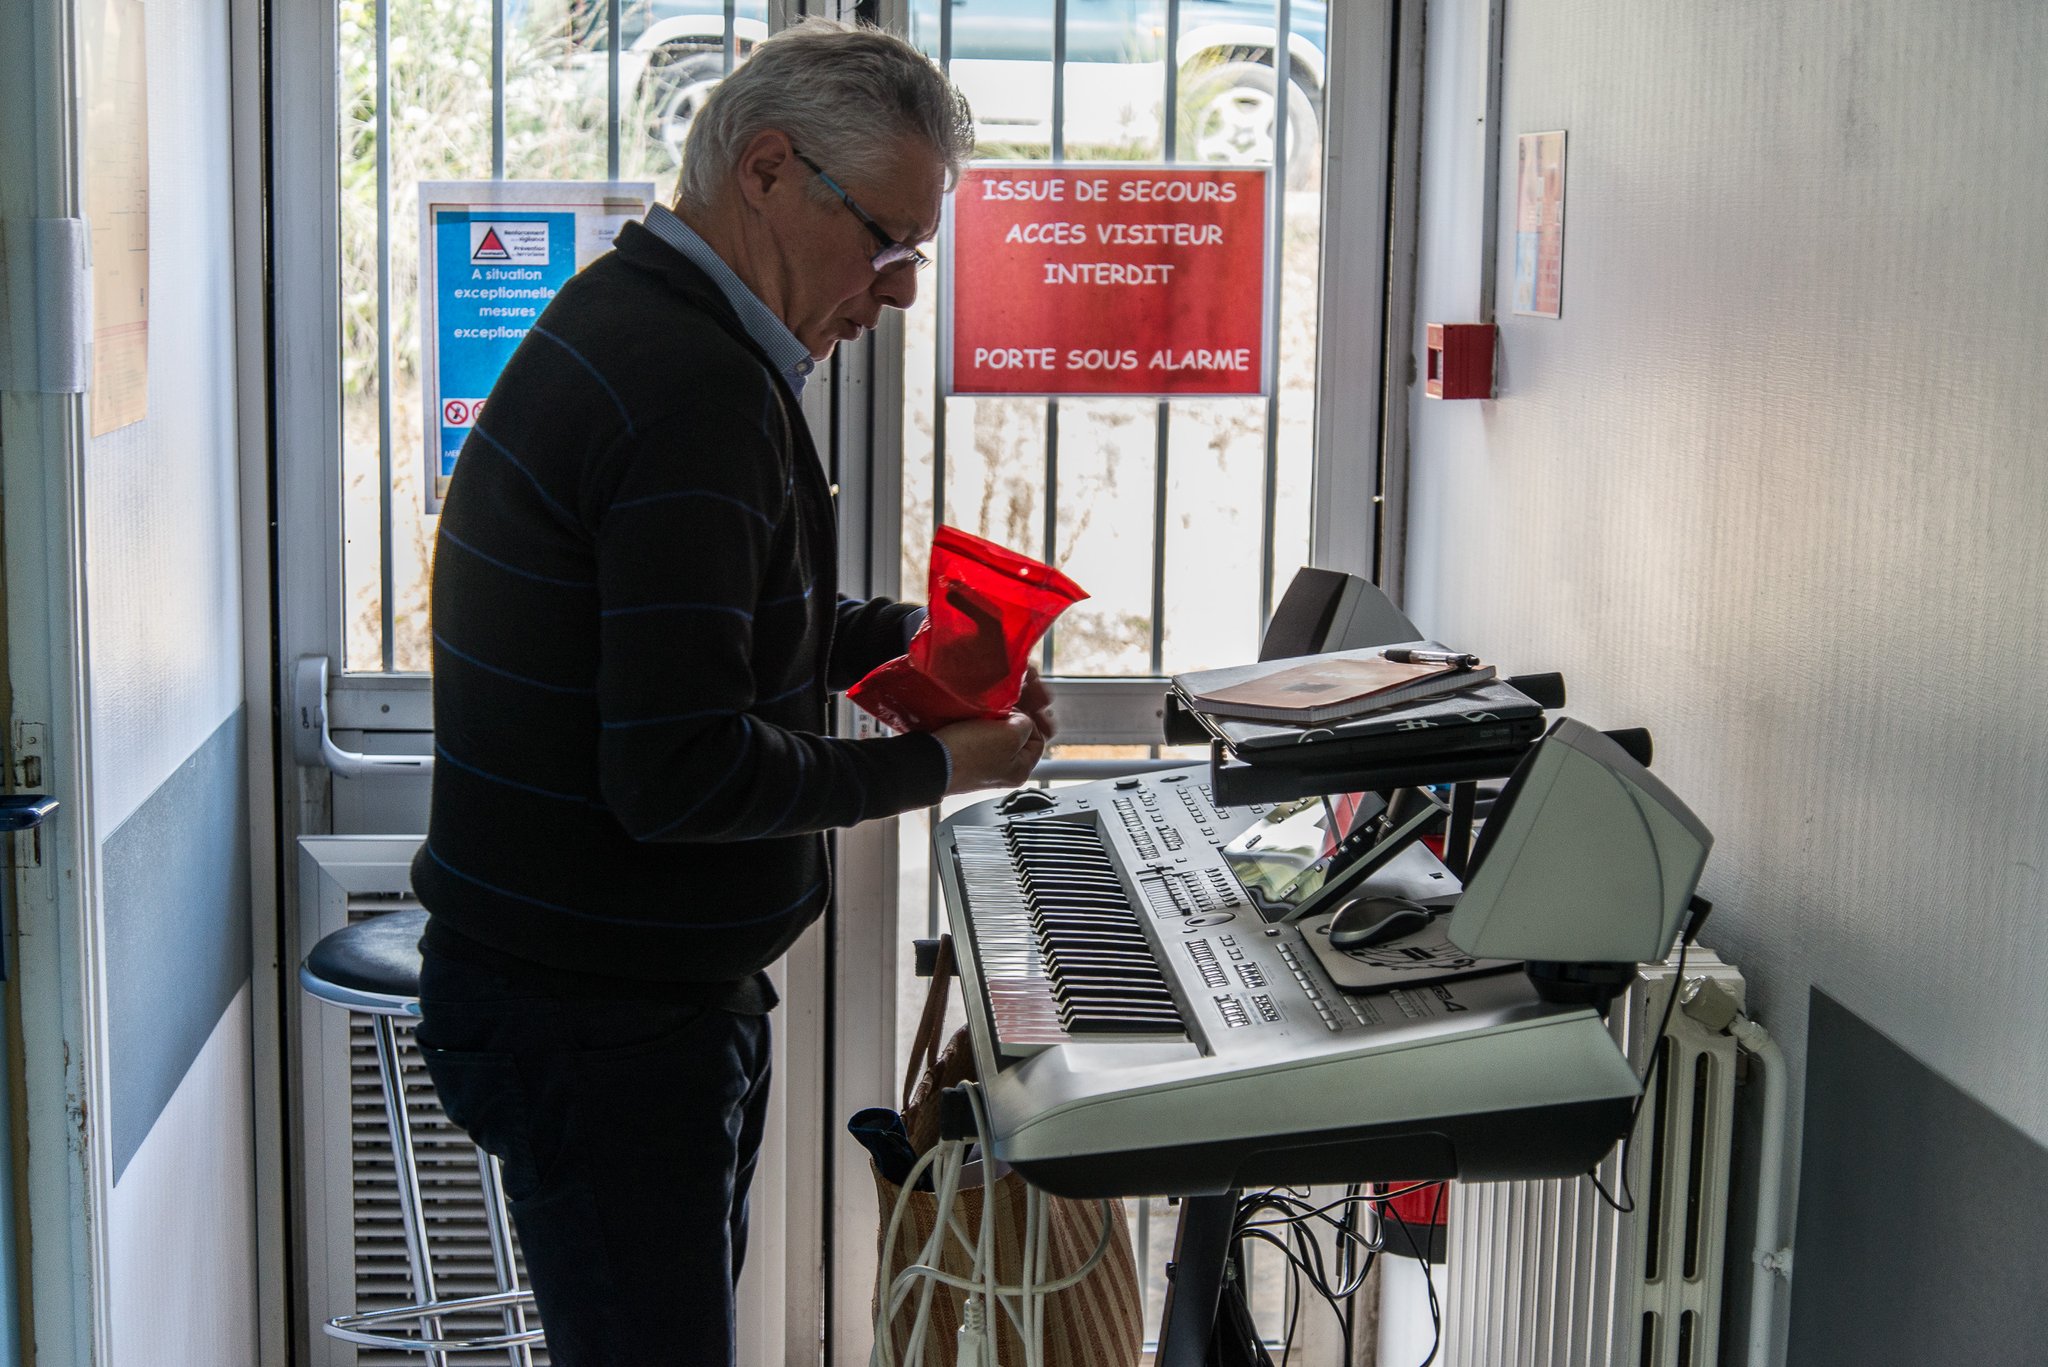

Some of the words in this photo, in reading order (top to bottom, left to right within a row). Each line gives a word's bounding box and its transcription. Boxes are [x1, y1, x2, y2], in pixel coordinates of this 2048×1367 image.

[982, 179, 1065, 202] ISSUE
[1075, 179, 1108, 202] DE
[1118, 181, 1238, 203] SECOURS
[1005, 222, 1087, 245] ACCES
[1096, 223, 1224, 246] VISITEUR
[471, 268, 482, 280] A
[485, 268, 542, 280] situation
[1042, 262, 1175, 285] INTERDIT
[454, 286, 556, 300] exceptionnelle
[479, 307, 536, 317] mesures
[974, 347, 1057, 370] PORTE
[1066, 348, 1139, 371] SOUS
[1149, 348, 1251, 371] ALARME
